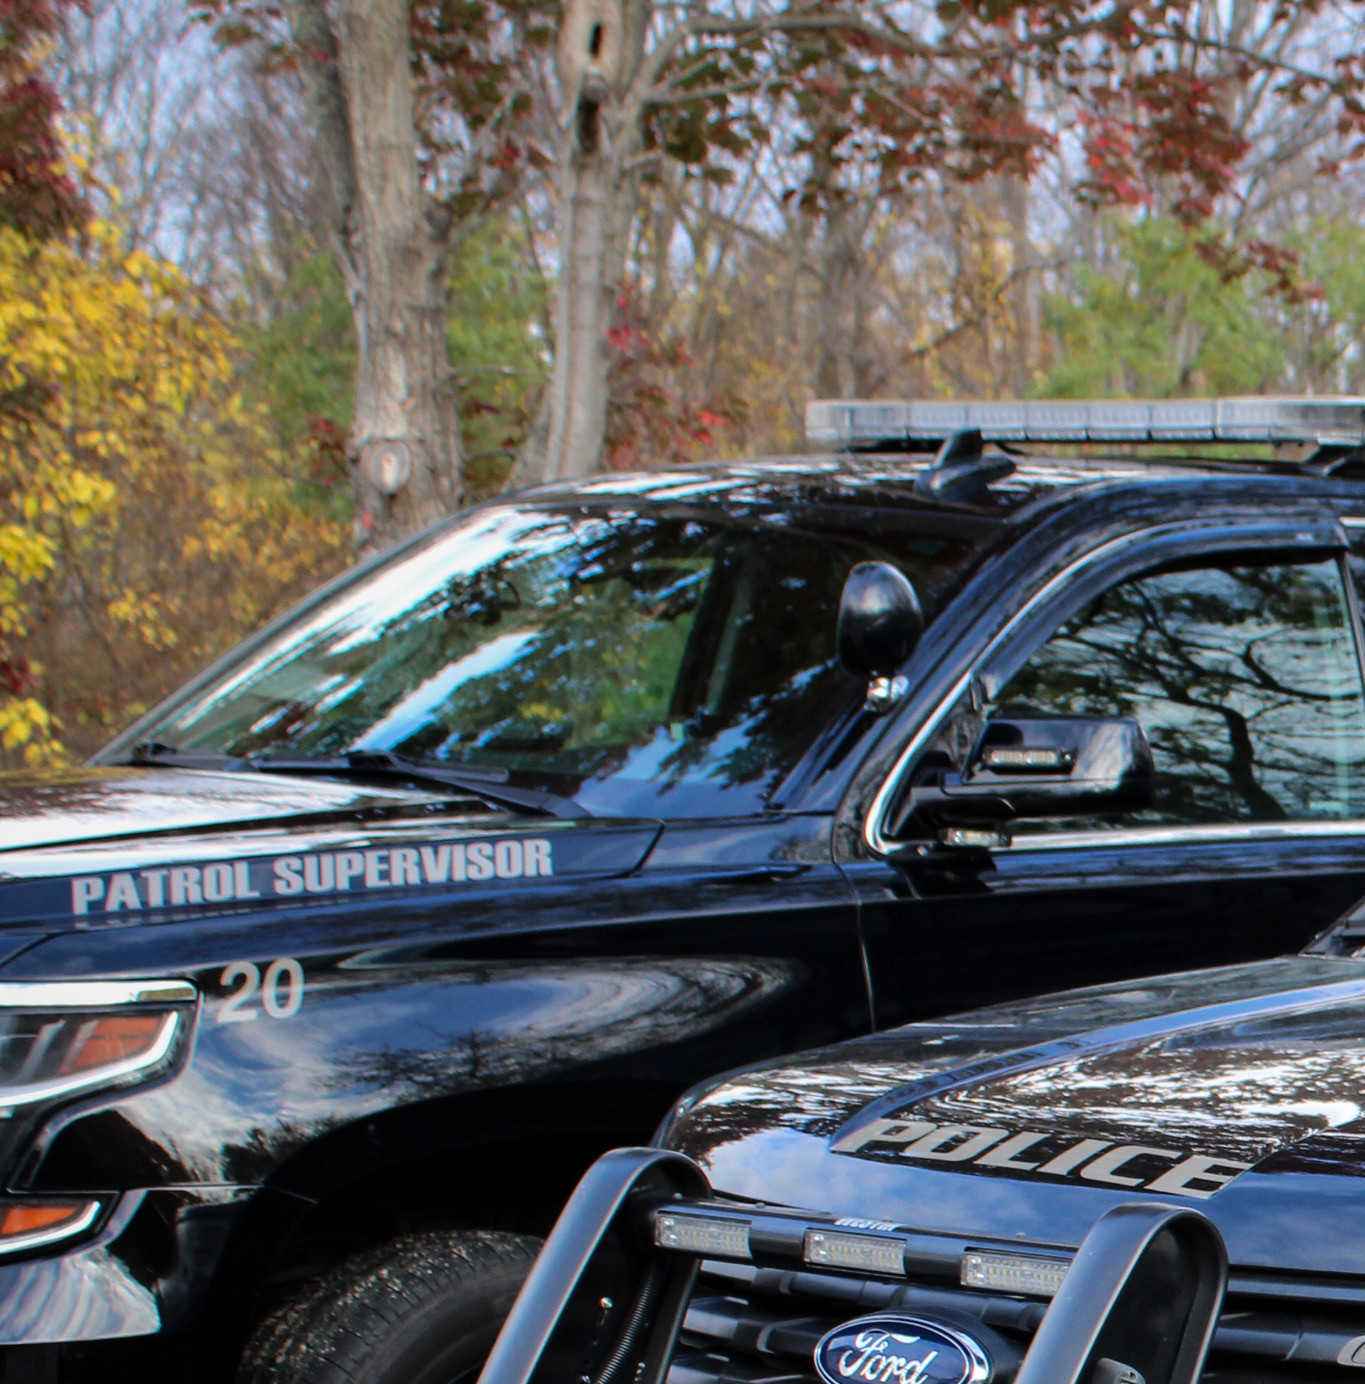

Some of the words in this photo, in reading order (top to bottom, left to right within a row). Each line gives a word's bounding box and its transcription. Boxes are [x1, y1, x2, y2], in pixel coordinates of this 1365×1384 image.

[72, 861, 260, 914] PATROL
[272, 838, 553, 896] SUPERVISOR
[216, 957, 305, 1024] 20
[830, 1118, 1257, 1199] POLICE
